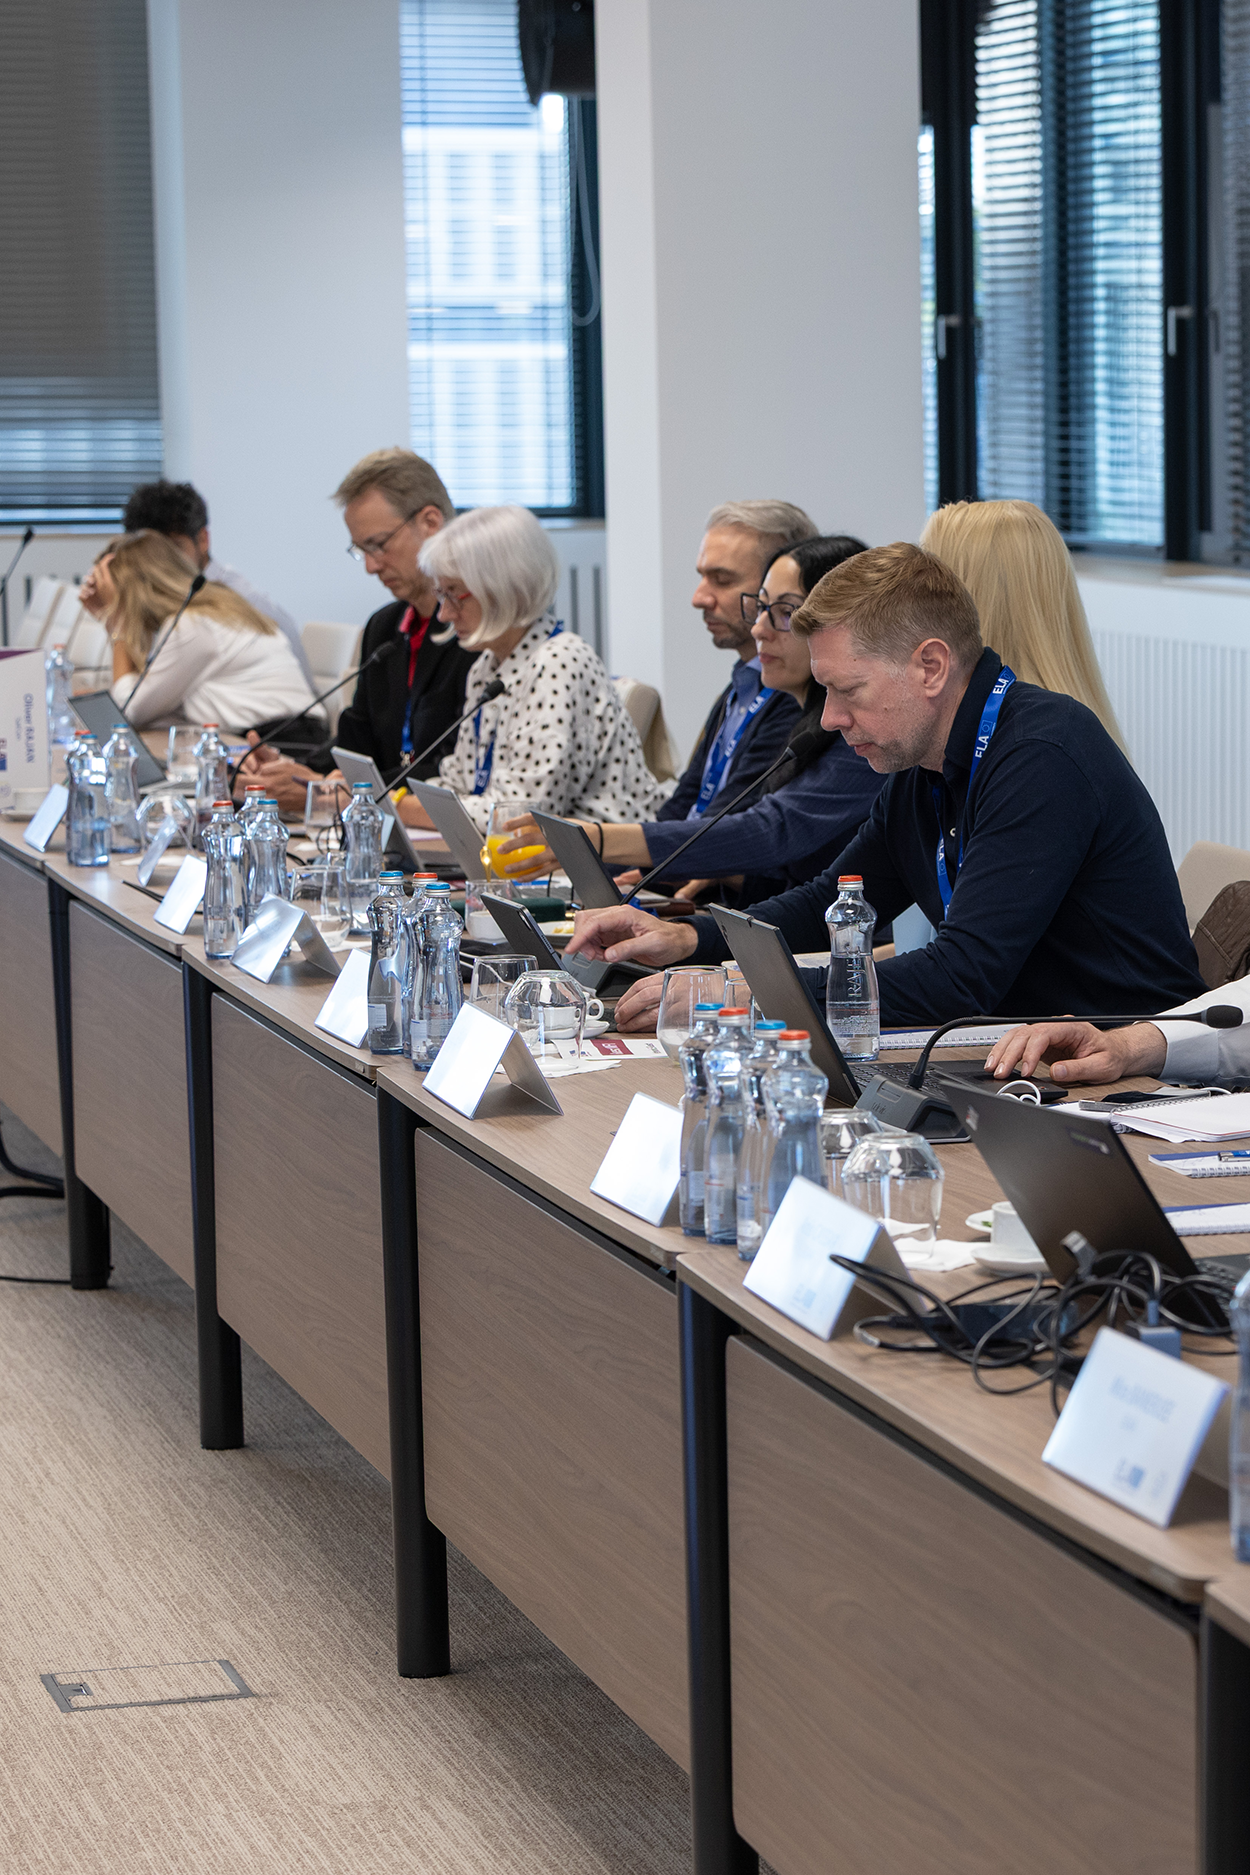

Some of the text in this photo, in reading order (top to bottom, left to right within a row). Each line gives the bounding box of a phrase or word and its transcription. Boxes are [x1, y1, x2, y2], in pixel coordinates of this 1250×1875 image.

[992, 678, 1010, 694] ELA
[748, 695, 765, 714] ELA
[701, 782, 716, 800] ELA
